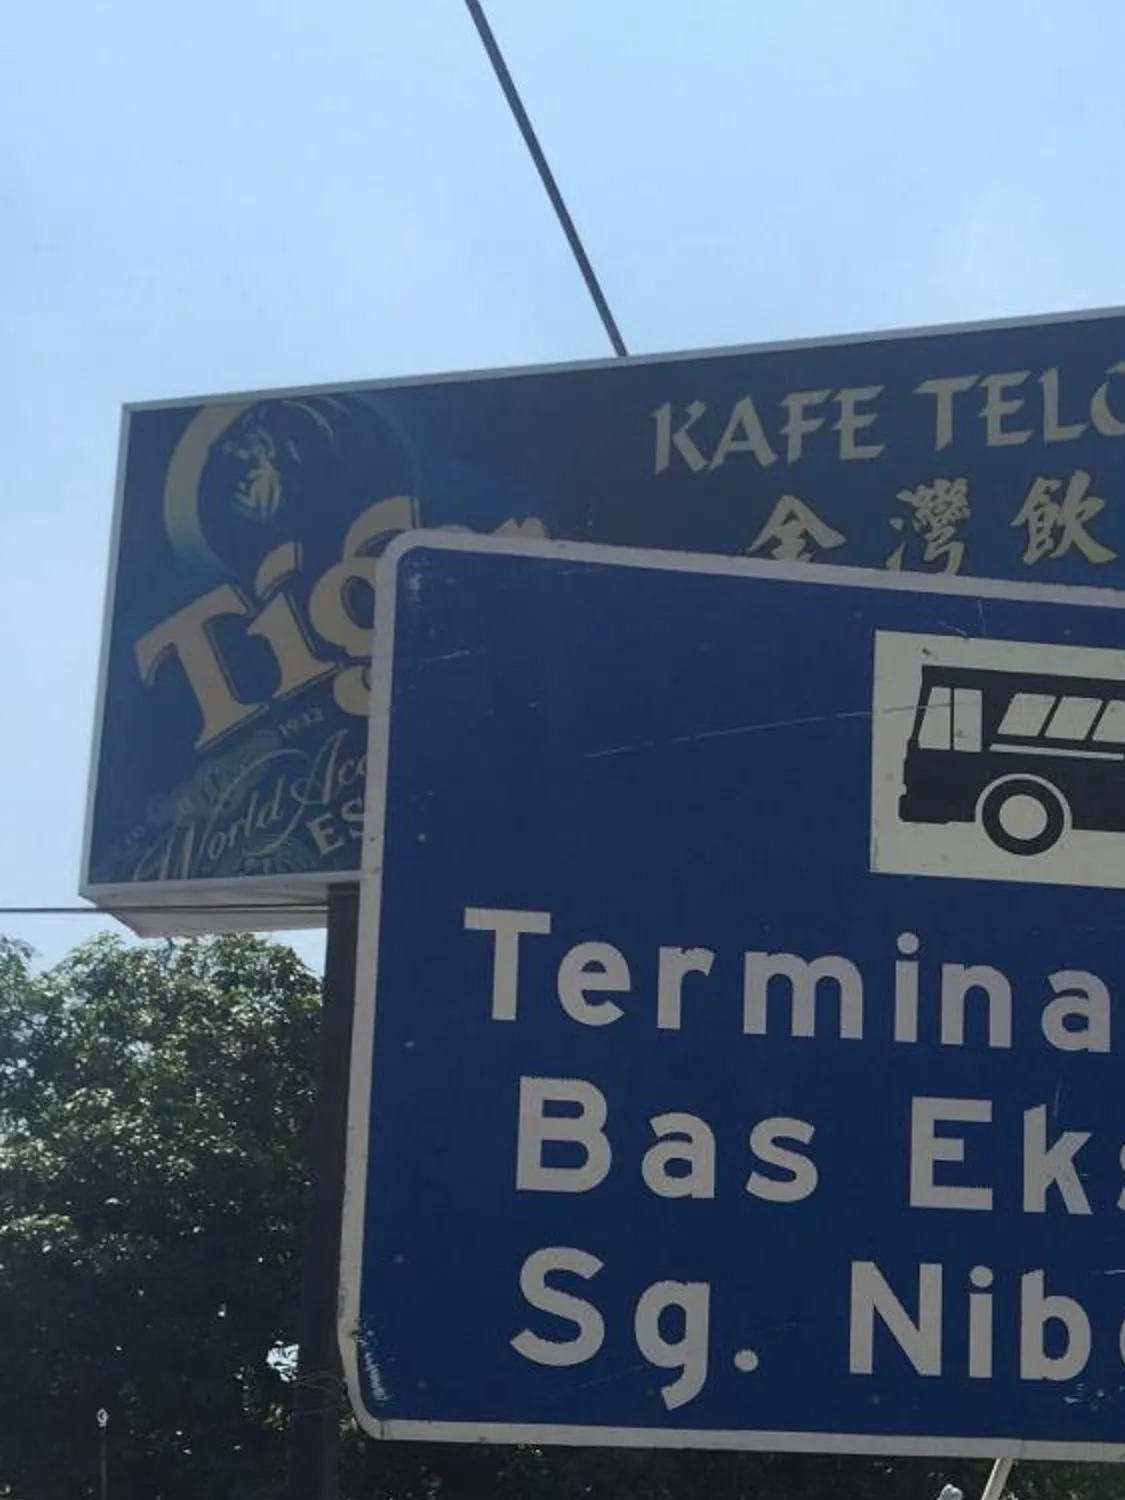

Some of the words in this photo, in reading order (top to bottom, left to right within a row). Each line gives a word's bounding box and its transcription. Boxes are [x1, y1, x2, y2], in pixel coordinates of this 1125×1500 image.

[650, 385, 886, 475] KAFE
[516, 1076, 818, 1203] Bas
[510, 1247, 758, 1410] Sg.
